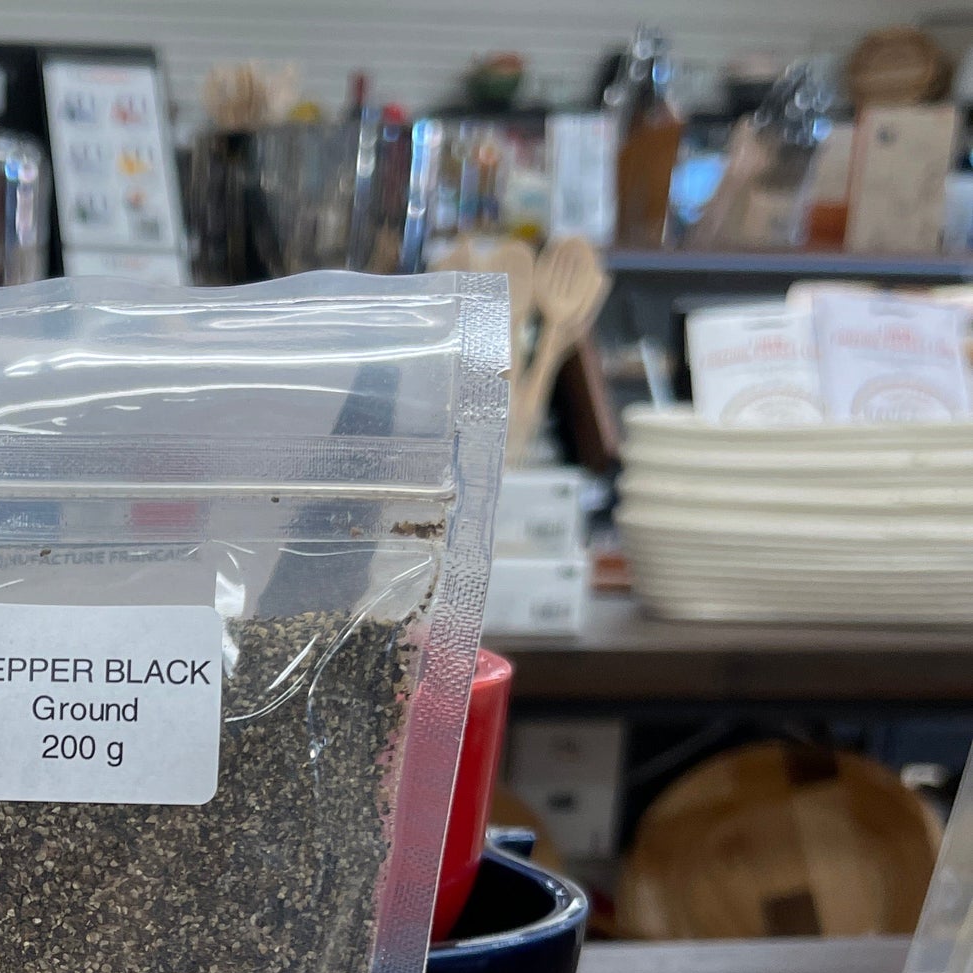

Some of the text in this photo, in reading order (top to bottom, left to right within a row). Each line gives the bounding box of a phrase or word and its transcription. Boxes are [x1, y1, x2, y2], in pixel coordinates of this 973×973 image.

[105, 658, 211, 685] BLACK
[32, 694, 139, 722] Ground
[41, 734, 124, 767] 200 g
